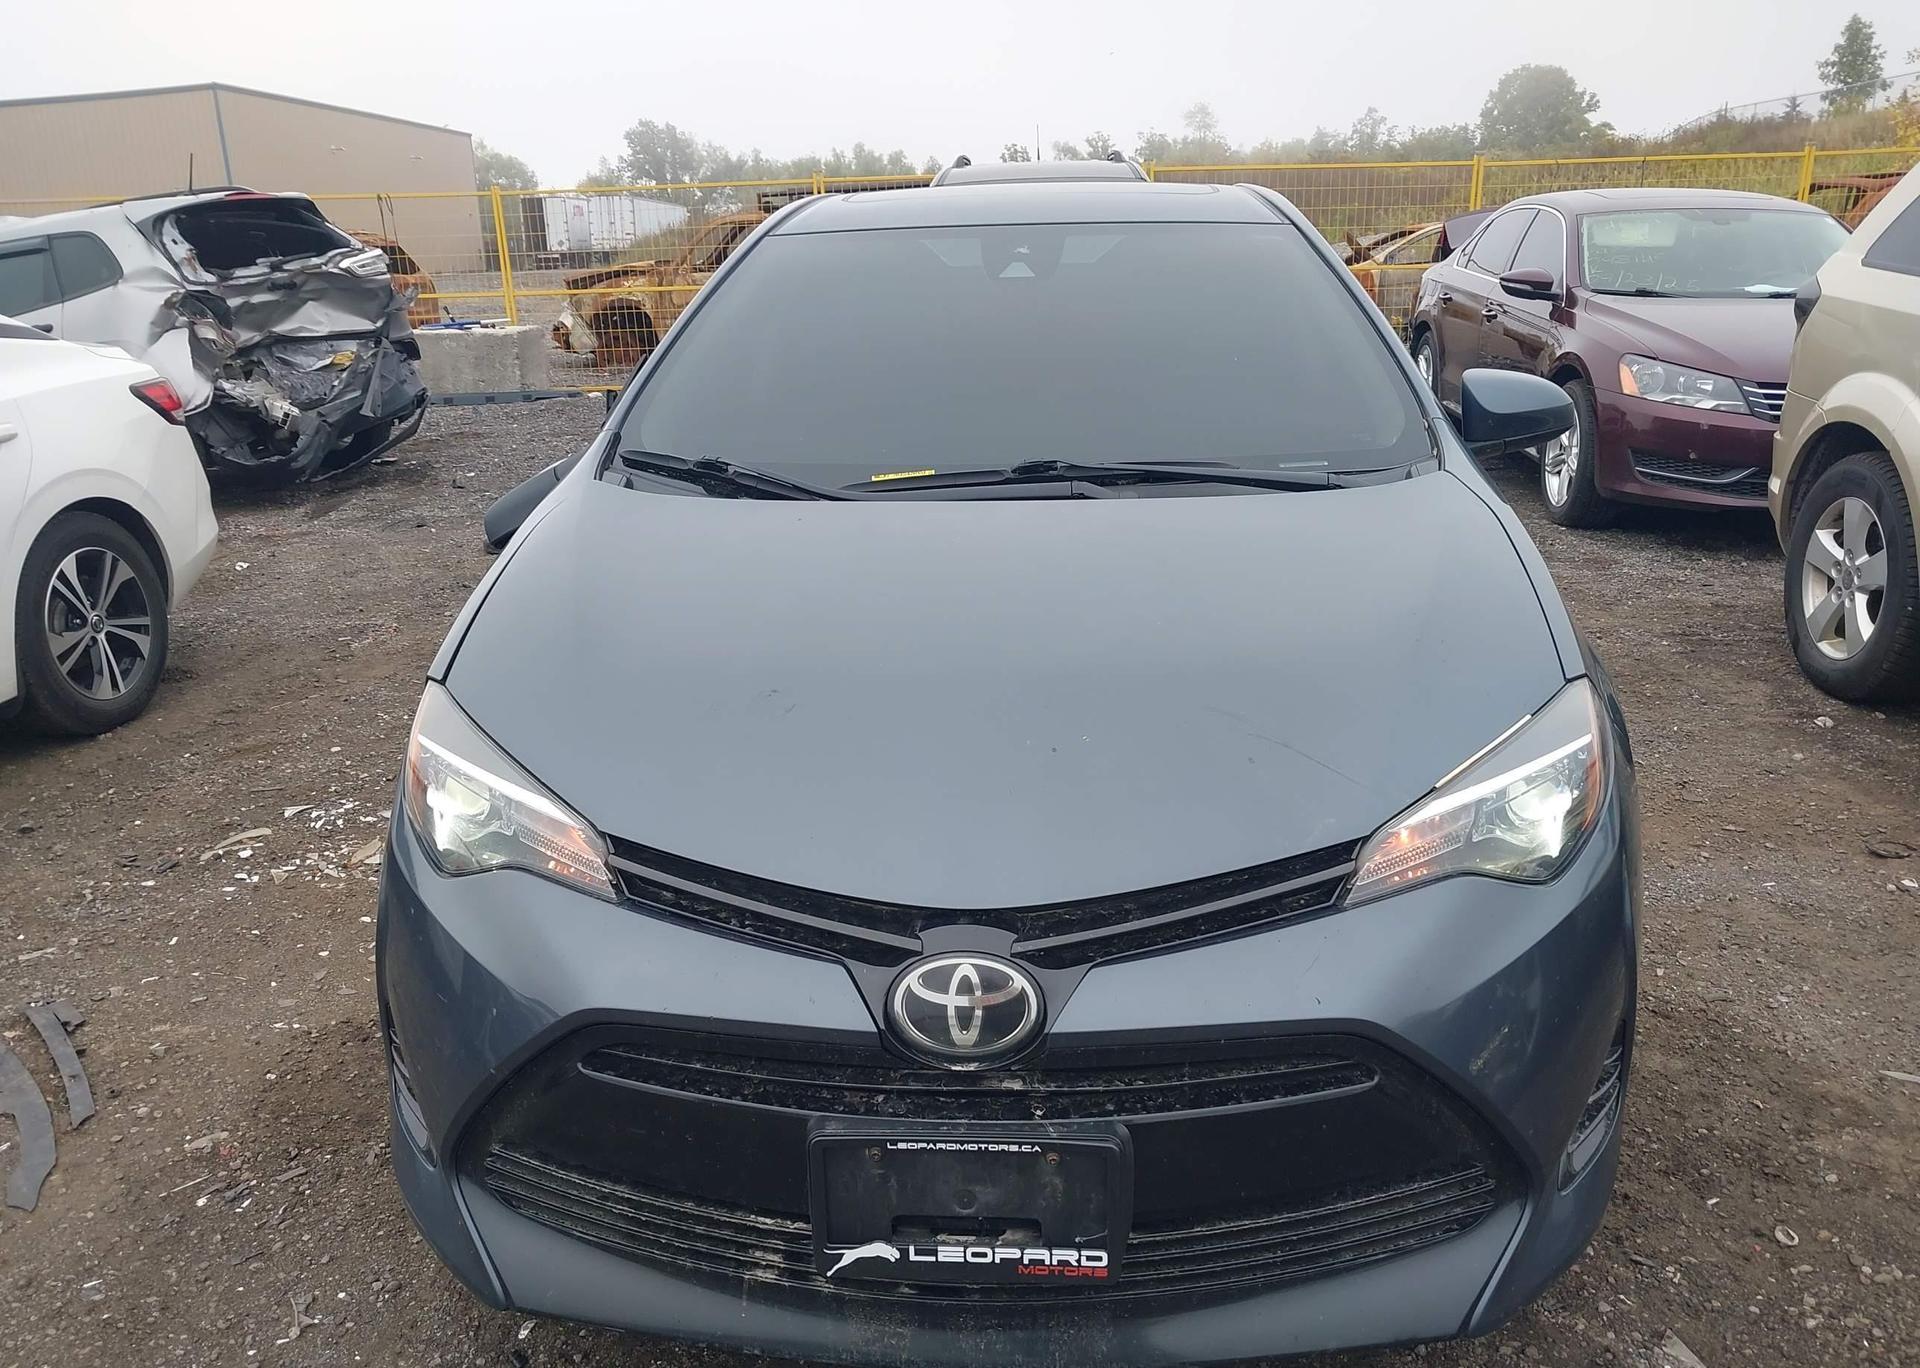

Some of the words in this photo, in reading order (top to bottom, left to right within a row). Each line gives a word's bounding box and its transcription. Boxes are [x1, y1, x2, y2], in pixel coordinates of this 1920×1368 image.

[886, 1141, 1042, 1153] LEOPARDMOTORS.CA
[908, 1245, 1109, 1267] LEOPARD
[1018, 1265, 1109, 1277] MOTORS
